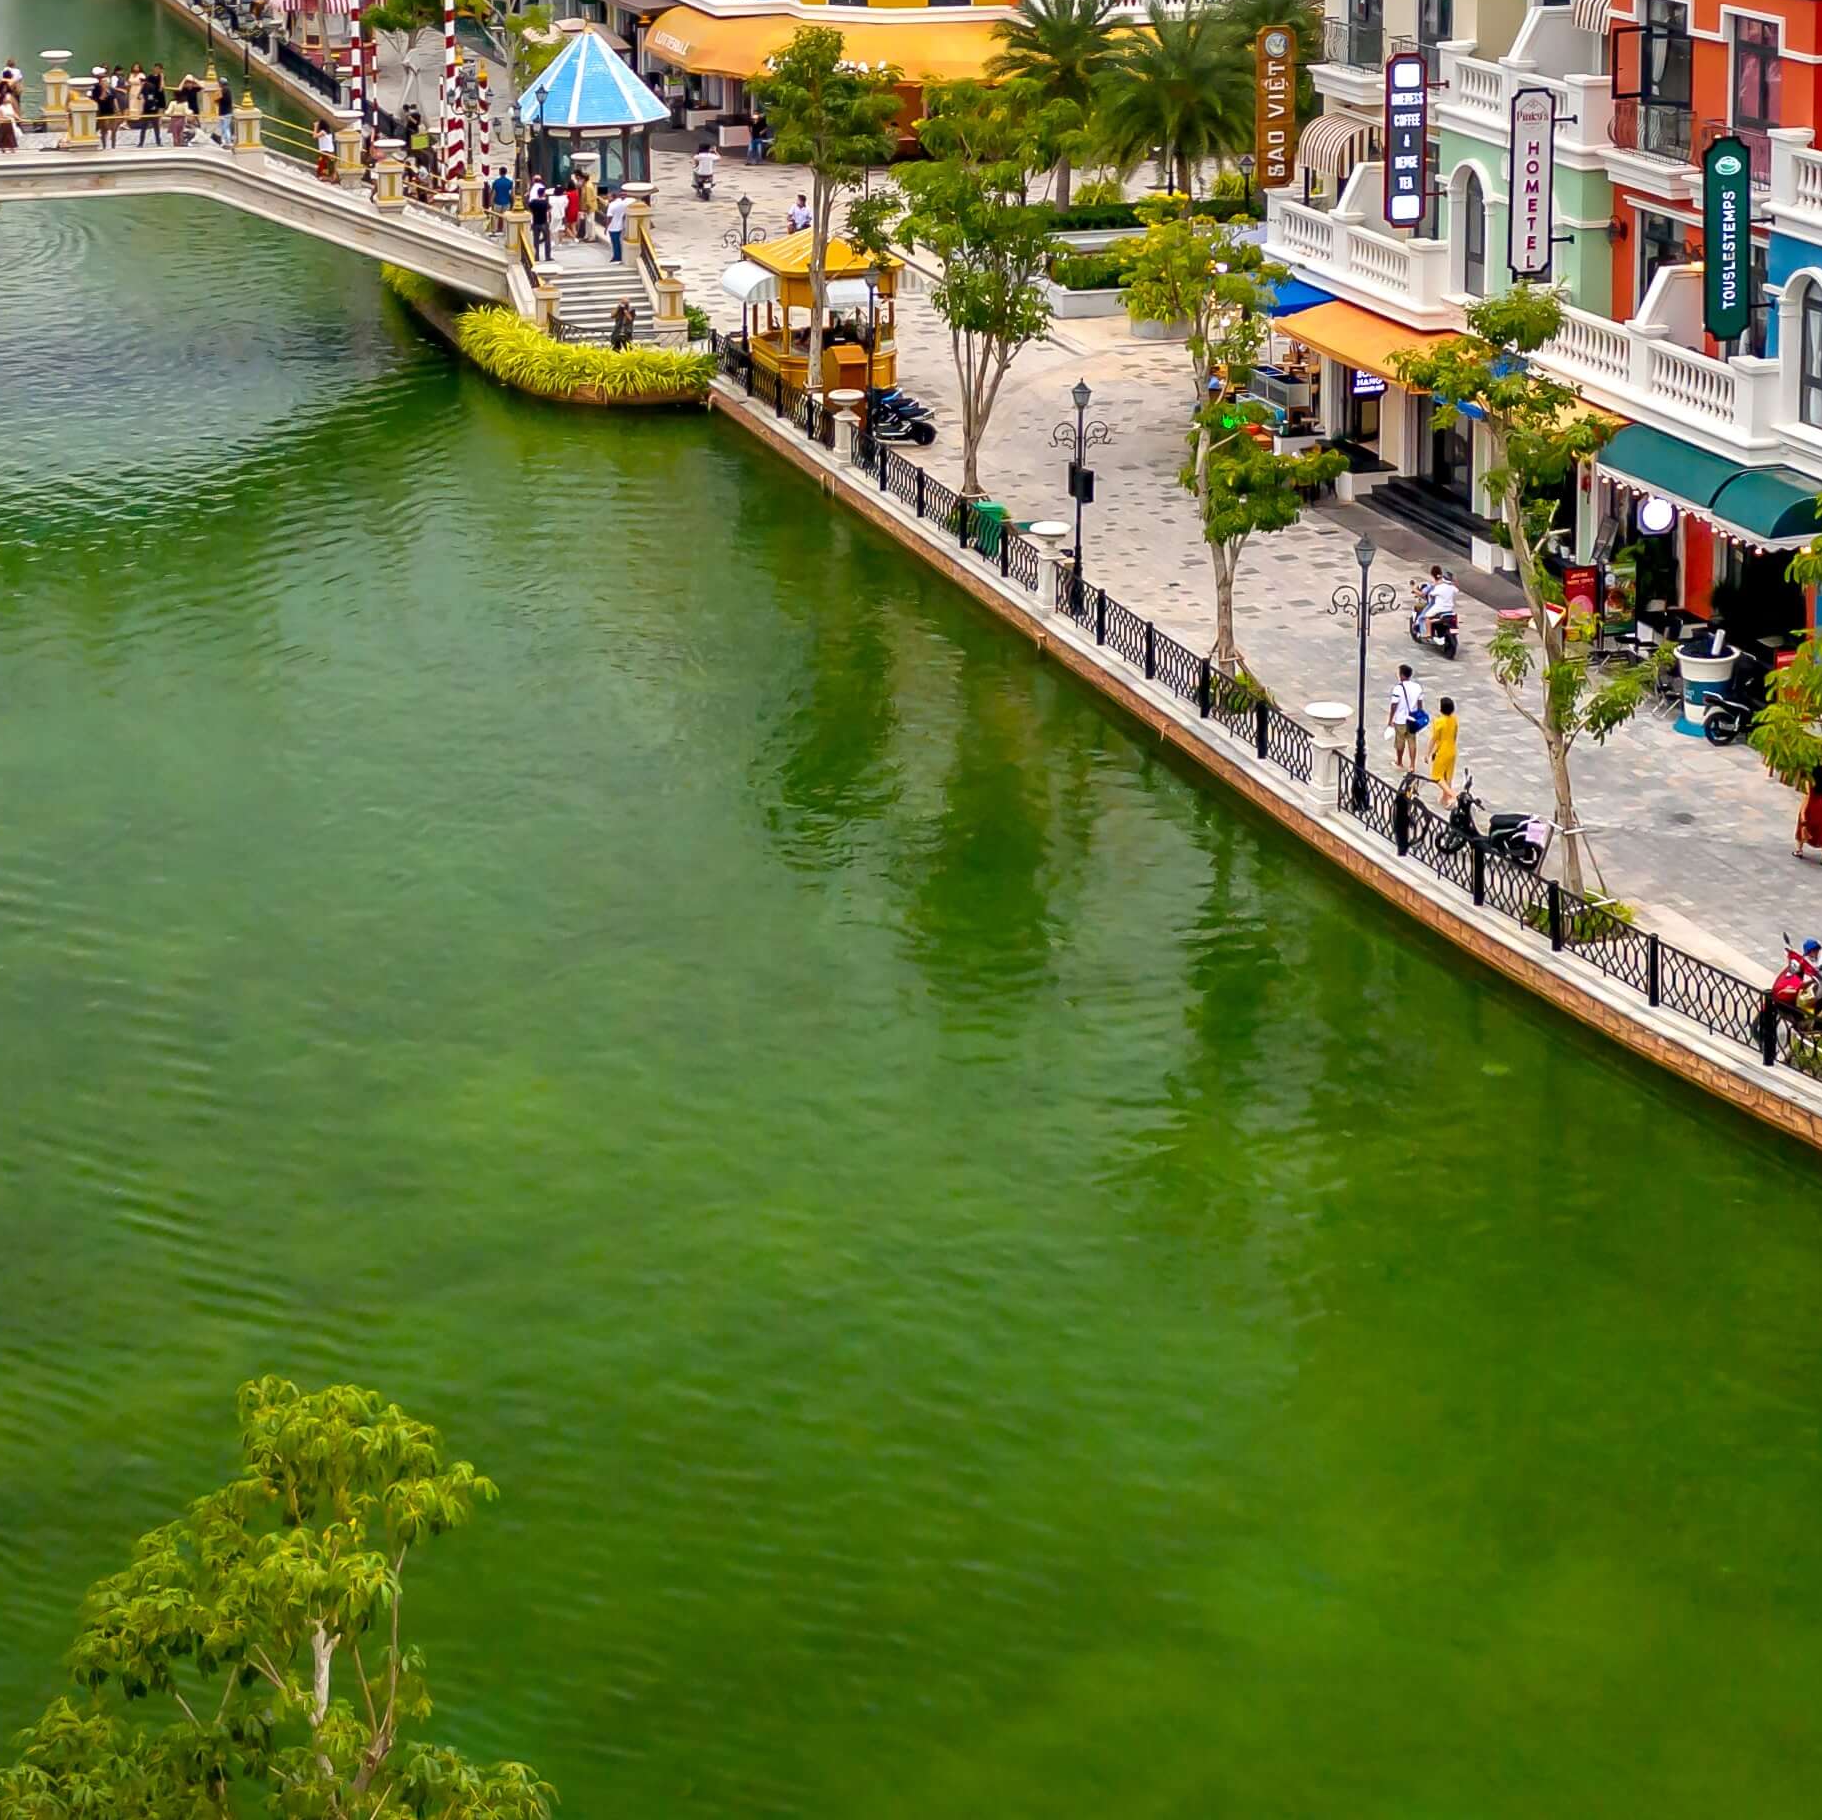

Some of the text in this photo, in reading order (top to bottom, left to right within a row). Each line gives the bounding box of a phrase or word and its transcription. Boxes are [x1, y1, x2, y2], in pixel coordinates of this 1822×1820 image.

[1263, 60, 1289, 119] VIỆT
[1393, 113, 1421, 127] COFFEE
[1524, 141, 1540, 269] HOMETEL
[1722, 189, 1737, 310] TOUSLESTEMPS
